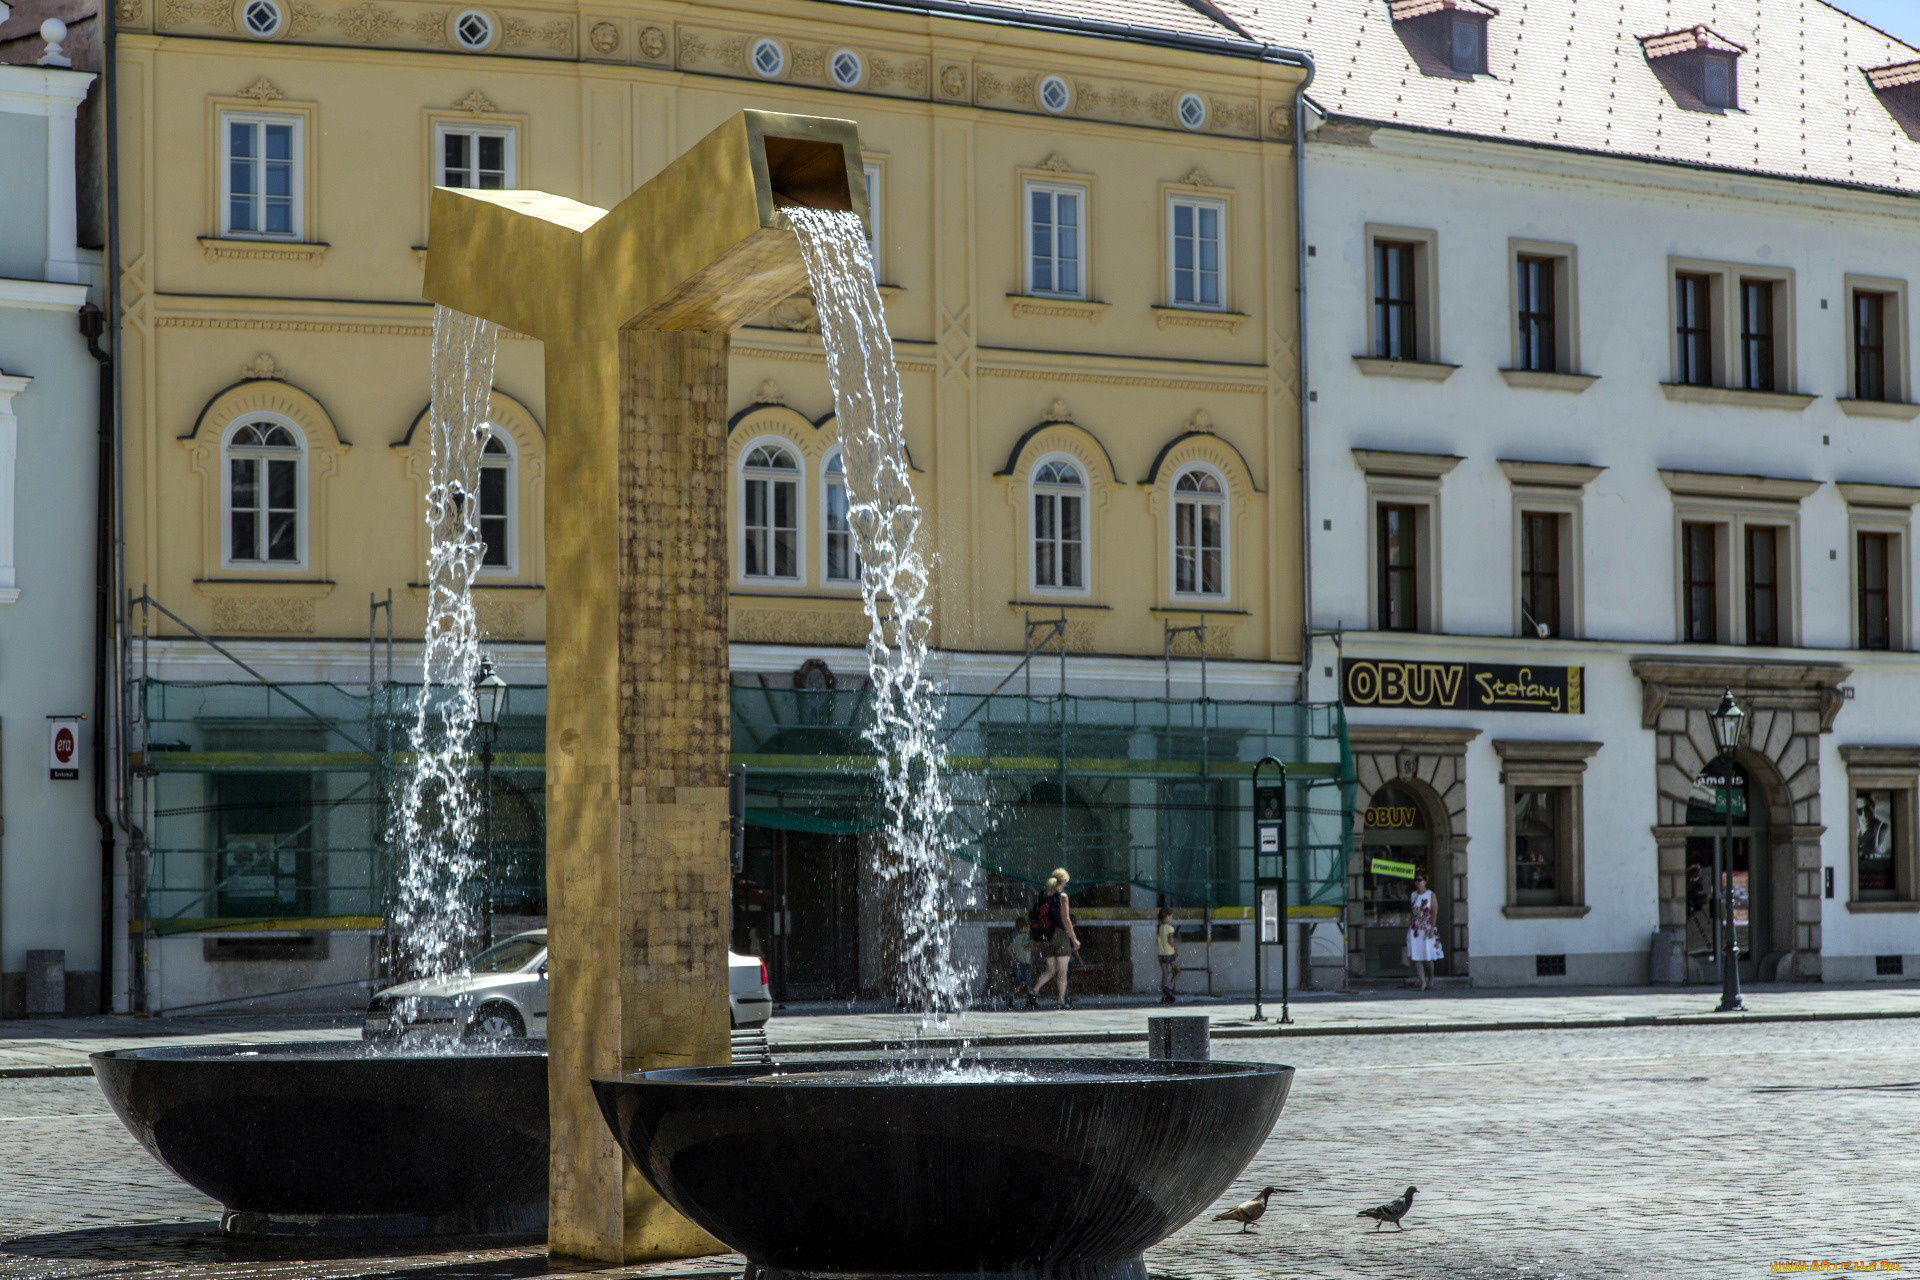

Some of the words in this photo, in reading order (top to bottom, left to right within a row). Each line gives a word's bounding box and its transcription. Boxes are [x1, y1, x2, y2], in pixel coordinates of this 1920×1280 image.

[1348, 661, 1464, 706] OBUV
[1475, 668, 1560, 711] Stefany
[57, 739, 71, 751] era
[1365, 807, 1416, 827] OBUV
